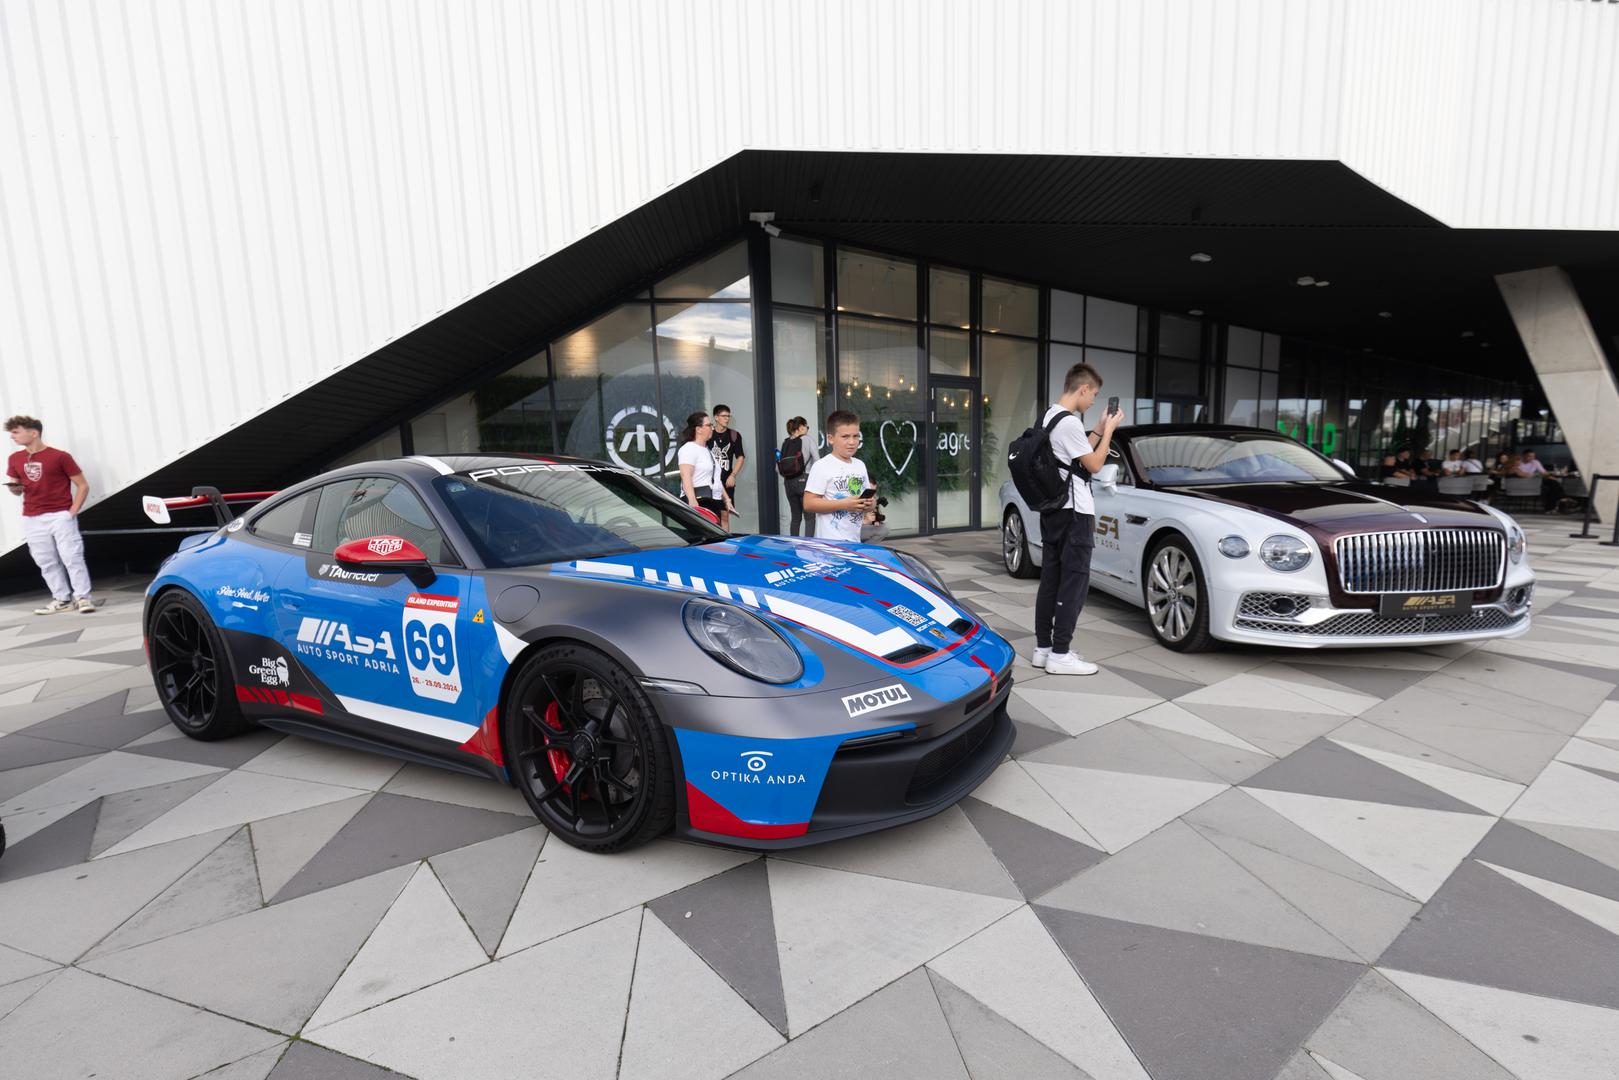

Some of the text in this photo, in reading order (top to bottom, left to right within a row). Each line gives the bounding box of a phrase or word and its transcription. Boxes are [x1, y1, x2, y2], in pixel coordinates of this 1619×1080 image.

[936, 432, 970, 456] agre
[469, 464, 620, 482] PORSCHE
[369, 544, 402, 554] HEUER
[407, 596, 457, 609] ISLAND EXPEDITION
[405, 619, 455, 676] 69
[262, 657, 276, 668] Big
[297, 643, 400, 675] AUTO SPORT ADRIA
[249, 664, 277, 676] Green
[261, 674, 278, 685] Egg
[848, 686, 908, 714] MOTUL
[711, 770, 806, 785] OPTIKA ANDA
